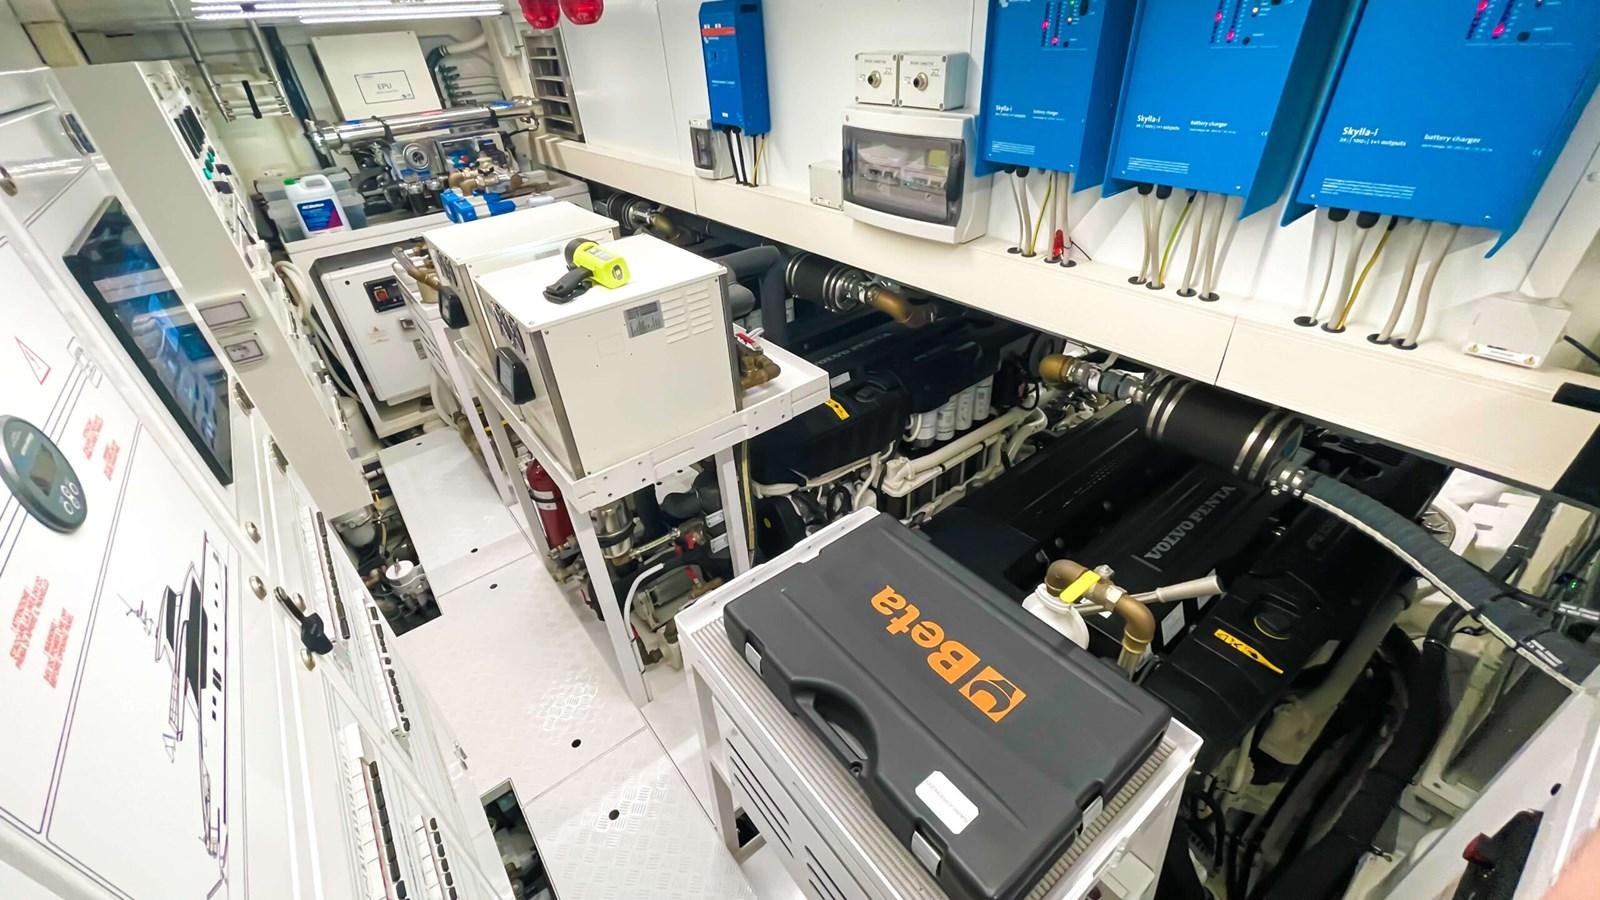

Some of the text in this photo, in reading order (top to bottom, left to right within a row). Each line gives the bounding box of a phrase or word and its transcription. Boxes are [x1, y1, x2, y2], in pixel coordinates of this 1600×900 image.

[1136, 114, 1161, 124] Skylla-i
[1342, 126, 1380, 140] Skylla-i
[1423, 133, 1481, 145] battery charger
[1144, 485, 1237, 560] VOLVO PENTA
[869, 584, 982, 686] Beta
